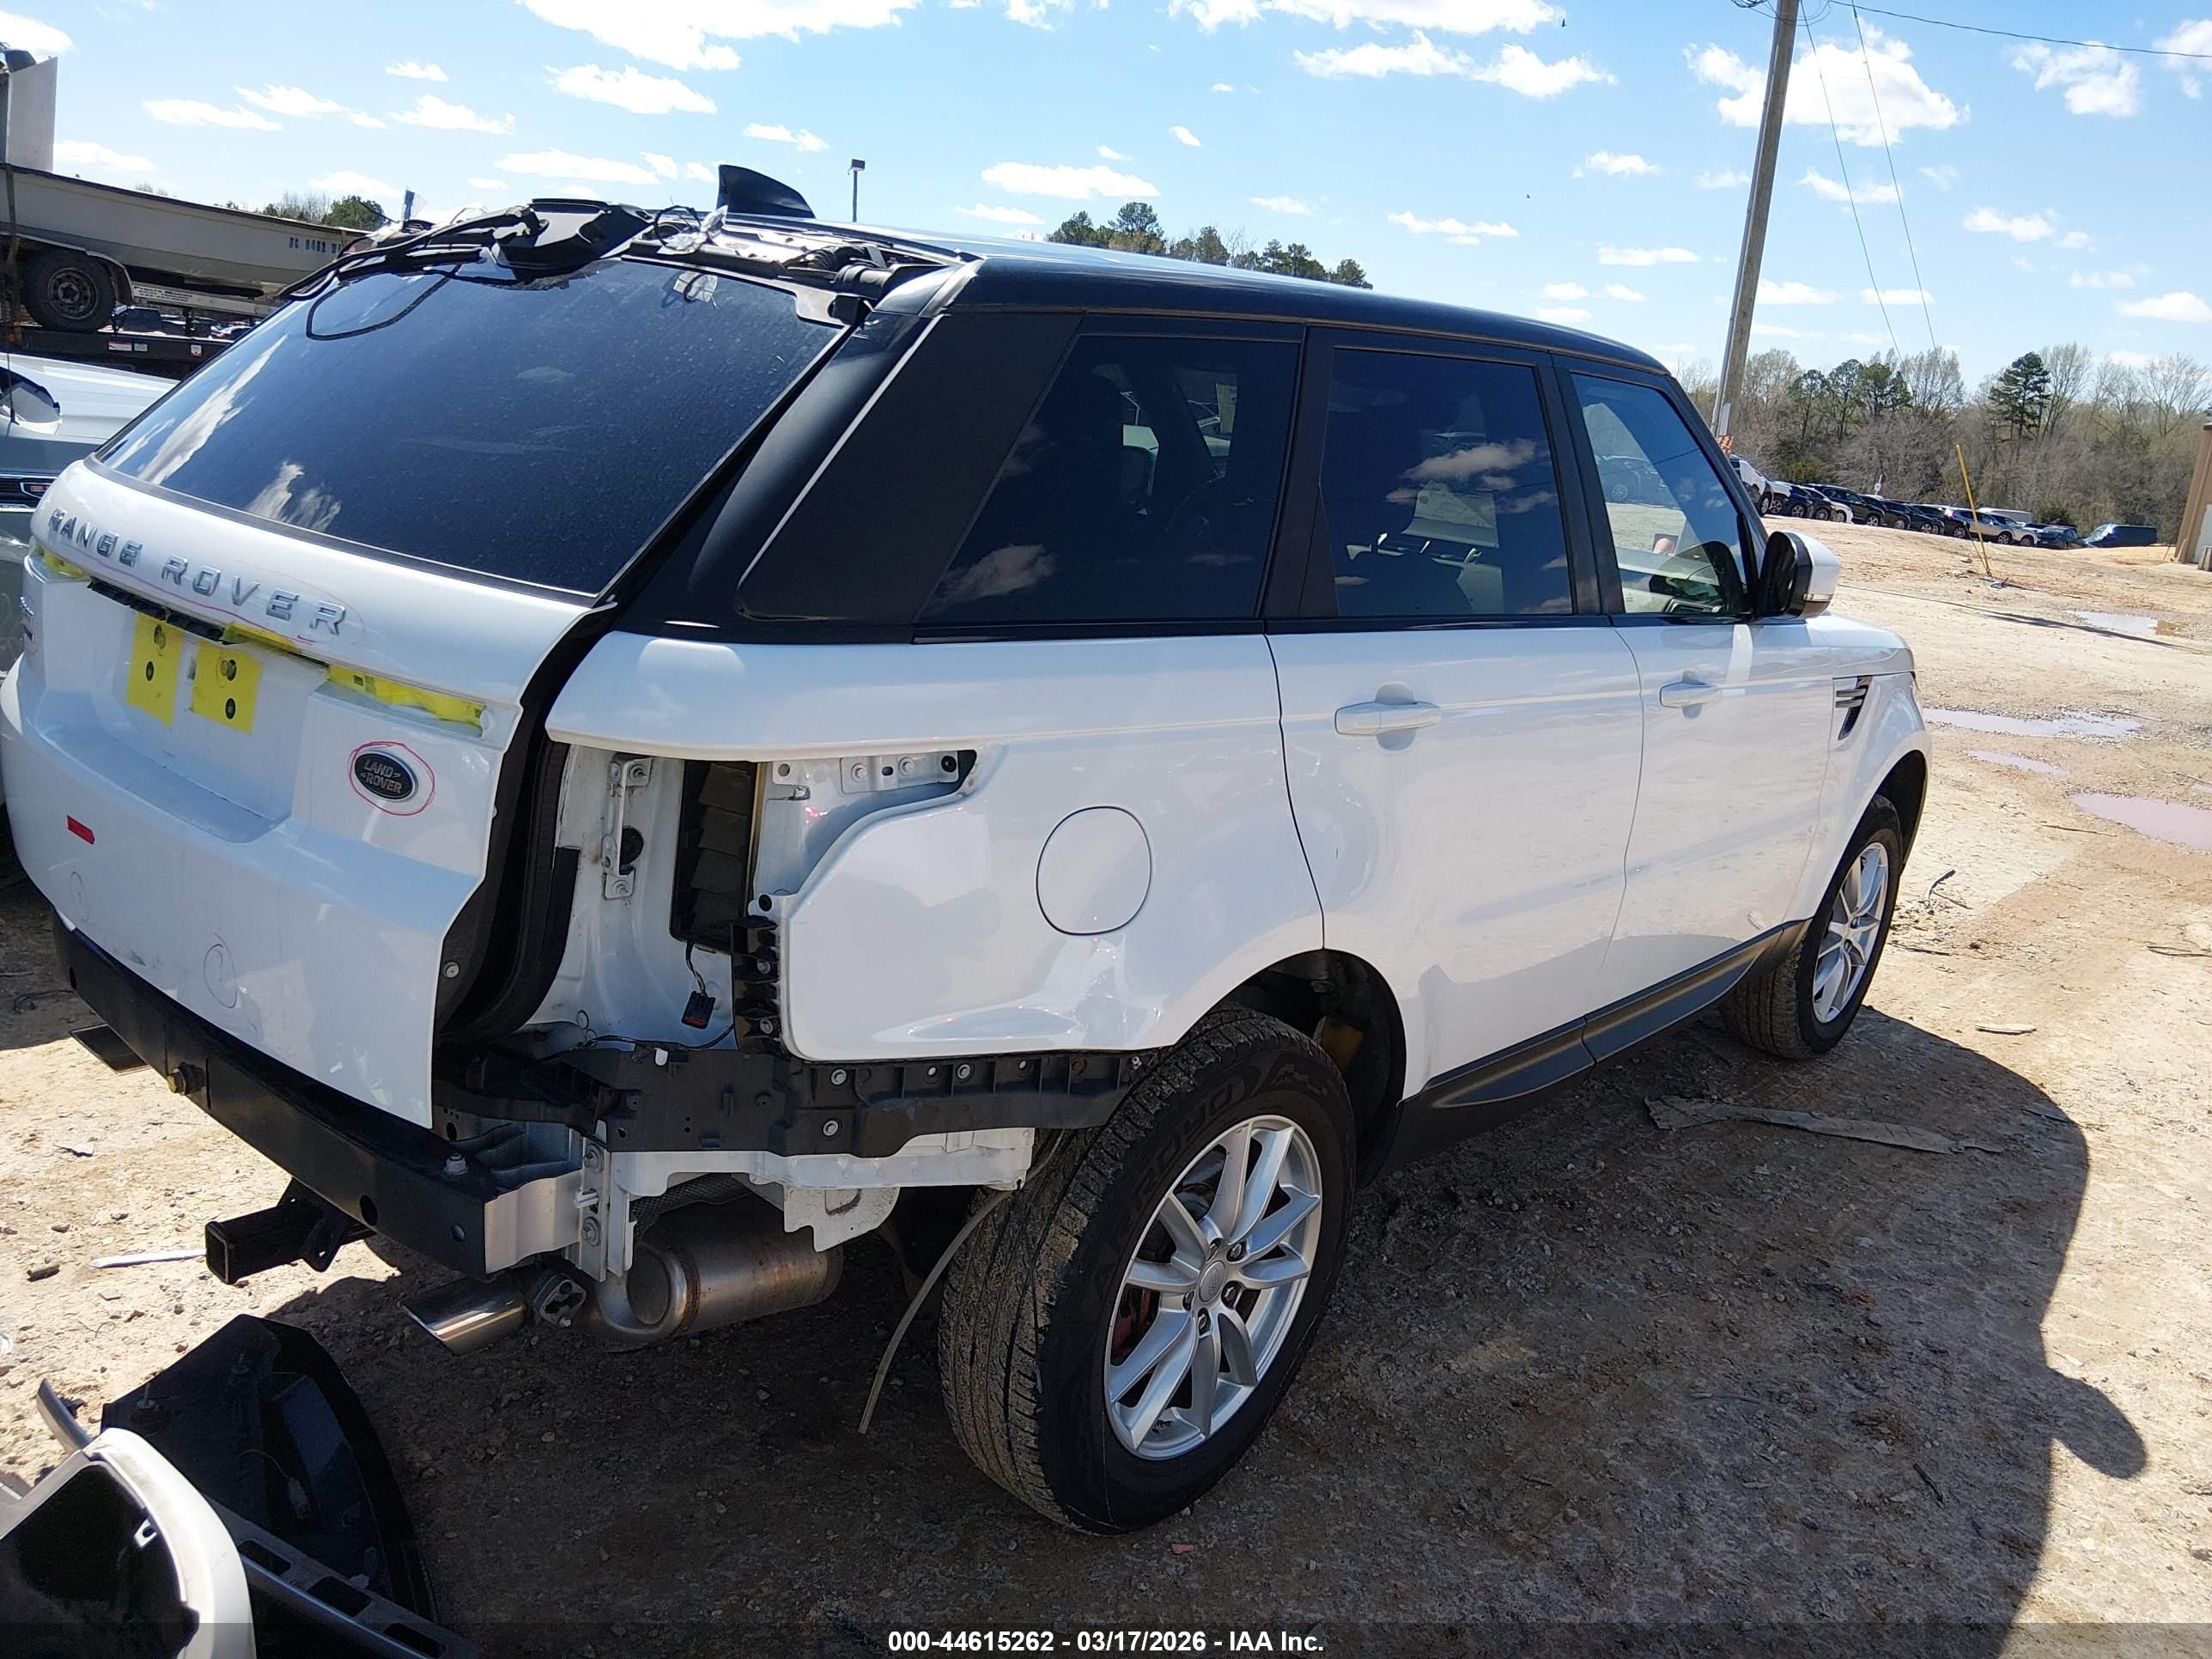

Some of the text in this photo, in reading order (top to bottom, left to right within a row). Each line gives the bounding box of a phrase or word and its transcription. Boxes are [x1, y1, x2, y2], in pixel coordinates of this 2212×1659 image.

[48, 507, 346, 635] RANGE ROVER
[364, 759, 394, 778] LAND
[365, 772, 403, 793] ROVER
